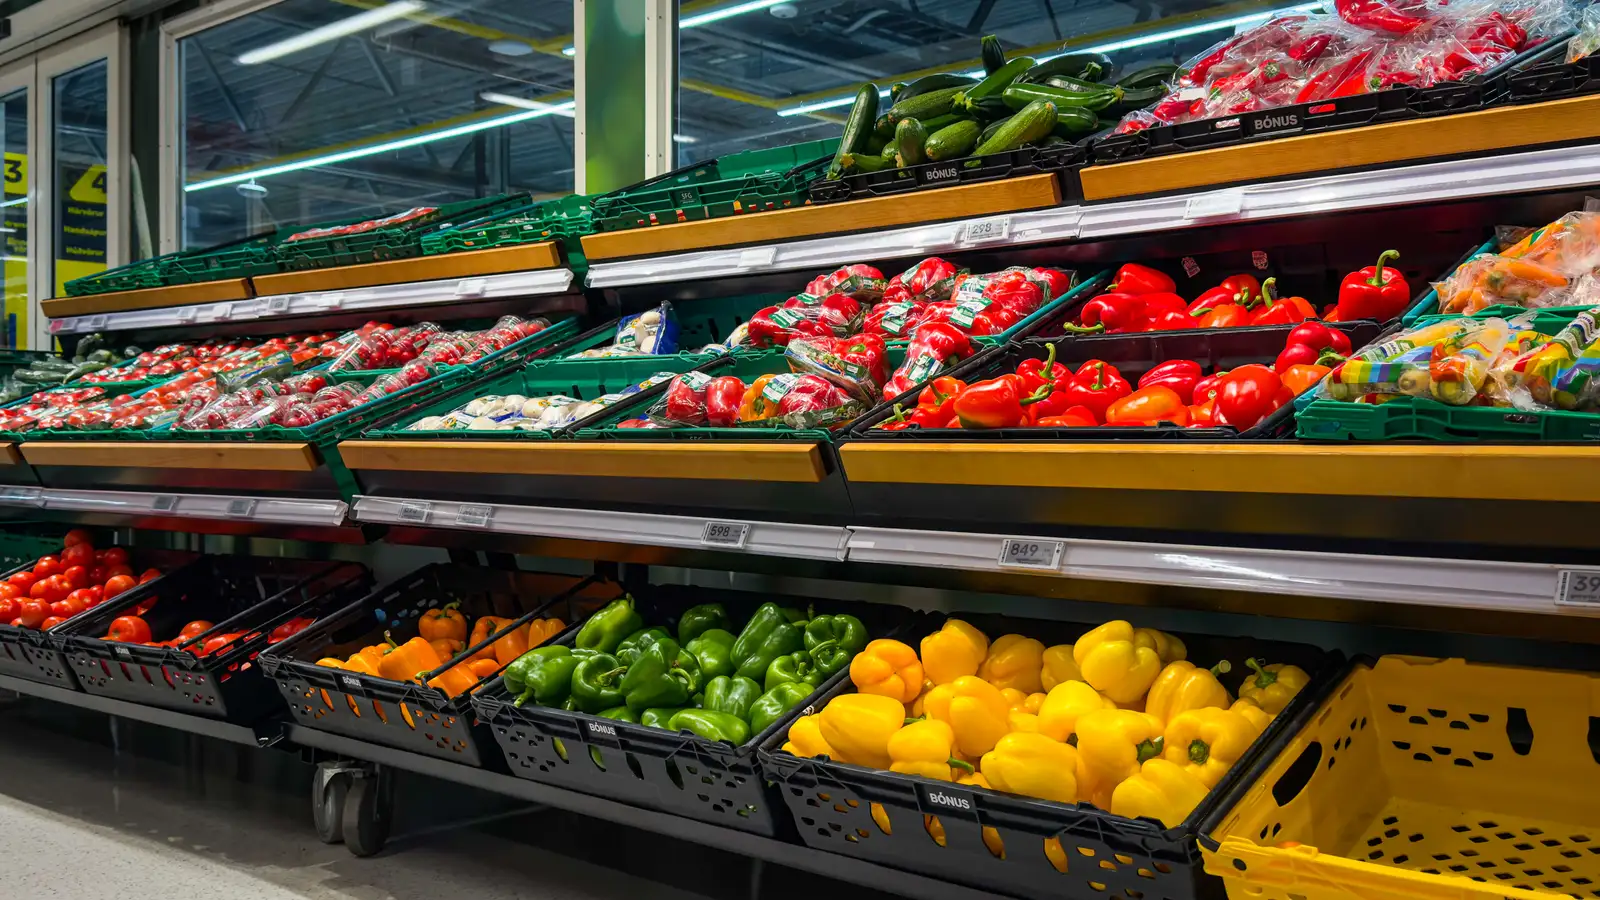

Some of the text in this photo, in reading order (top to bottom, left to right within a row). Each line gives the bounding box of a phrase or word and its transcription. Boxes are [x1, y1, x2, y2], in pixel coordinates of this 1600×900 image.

[1254, 115, 1298, 129] BÓNUS
[4, 159, 22, 183] 3
[926, 168, 958, 180] BÓNUS
[972, 222, 992, 234] 298
[710, 525, 730, 537] 598
[1010, 543, 1039, 556] 849
[588, 721, 616, 735] BÓNUS
[929, 791, 970, 809] BÓNUS
